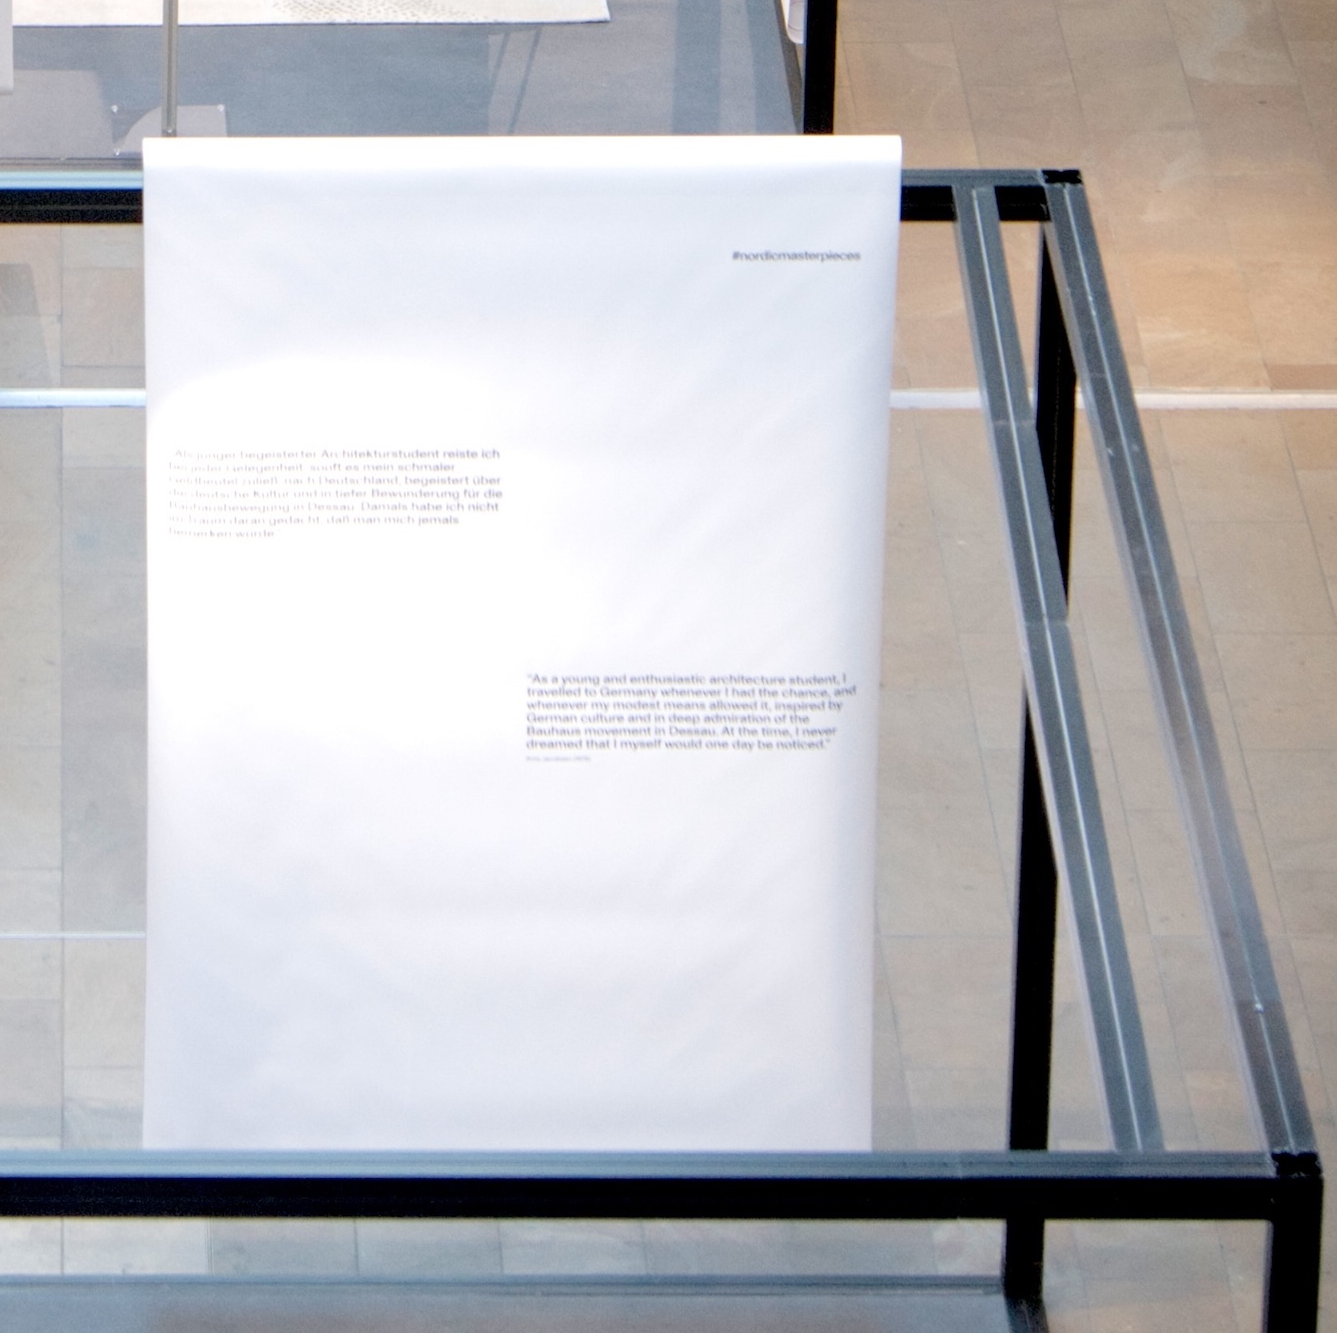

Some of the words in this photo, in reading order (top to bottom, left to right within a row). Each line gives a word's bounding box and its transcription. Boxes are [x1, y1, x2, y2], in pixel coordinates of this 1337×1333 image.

[732, 249, 862, 263] #nordicmasterpieces
[562, 676, 600, 686] young
[604, 674, 626, 683] and
[630, 674, 706, 684] enthusiastic
[709, 674, 786, 684] architecture
[789, 674, 840, 686] student,
[527, 687, 581, 696] travelled
[585, 688, 596, 696] to
[600, 687, 657, 699] Germany
[661, 687, 721, 697] whenever
[732, 687, 755, 697] had
[759, 687, 778, 697] the
[782, 687, 831, 699] chance,
[834, 685, 856, 696] and
[527, 700, 588, 710] whenever
[591, 702, 609, 712] my
[613, 701, 660, 710] modest
[663, 702, 705, 710] means
[709, 700, 757, 710] allowed
[761, 701, 772, 712] it,
[775, 701, 825, 715] inspired
[828, 700, 843, 713] by
[527, 713, 577, 723] German
[581, 713, 624, 723] culture
[628, 713, 651, 723] and
[654, 713, 664, 723] in
[669, 713, 700, 725] deep
[704, 714, 770, 723] admiration
[774, 714, 786, 723] of
[790, 714, 810, 724] the
[527, 726, 581, 736] Bauhaus
[585, 727, 651, 736] movement
[654, 726, 665, 736] in
[669, 726, 715, 736] Dessau.
[721, 727, 734, 736] At
[738, 727, 758, 736] the
[762, 727, 792, 738] time,
[802, 728, 836, 736] never
[526, 739, 582, 749] dreamed
[586, 740, 610, 749] that
[620, 739, 661, 751] myself
[665, 740, 702, 749] would
[732, 740, 754, 751] day
[757, 740, 773, 749] be
